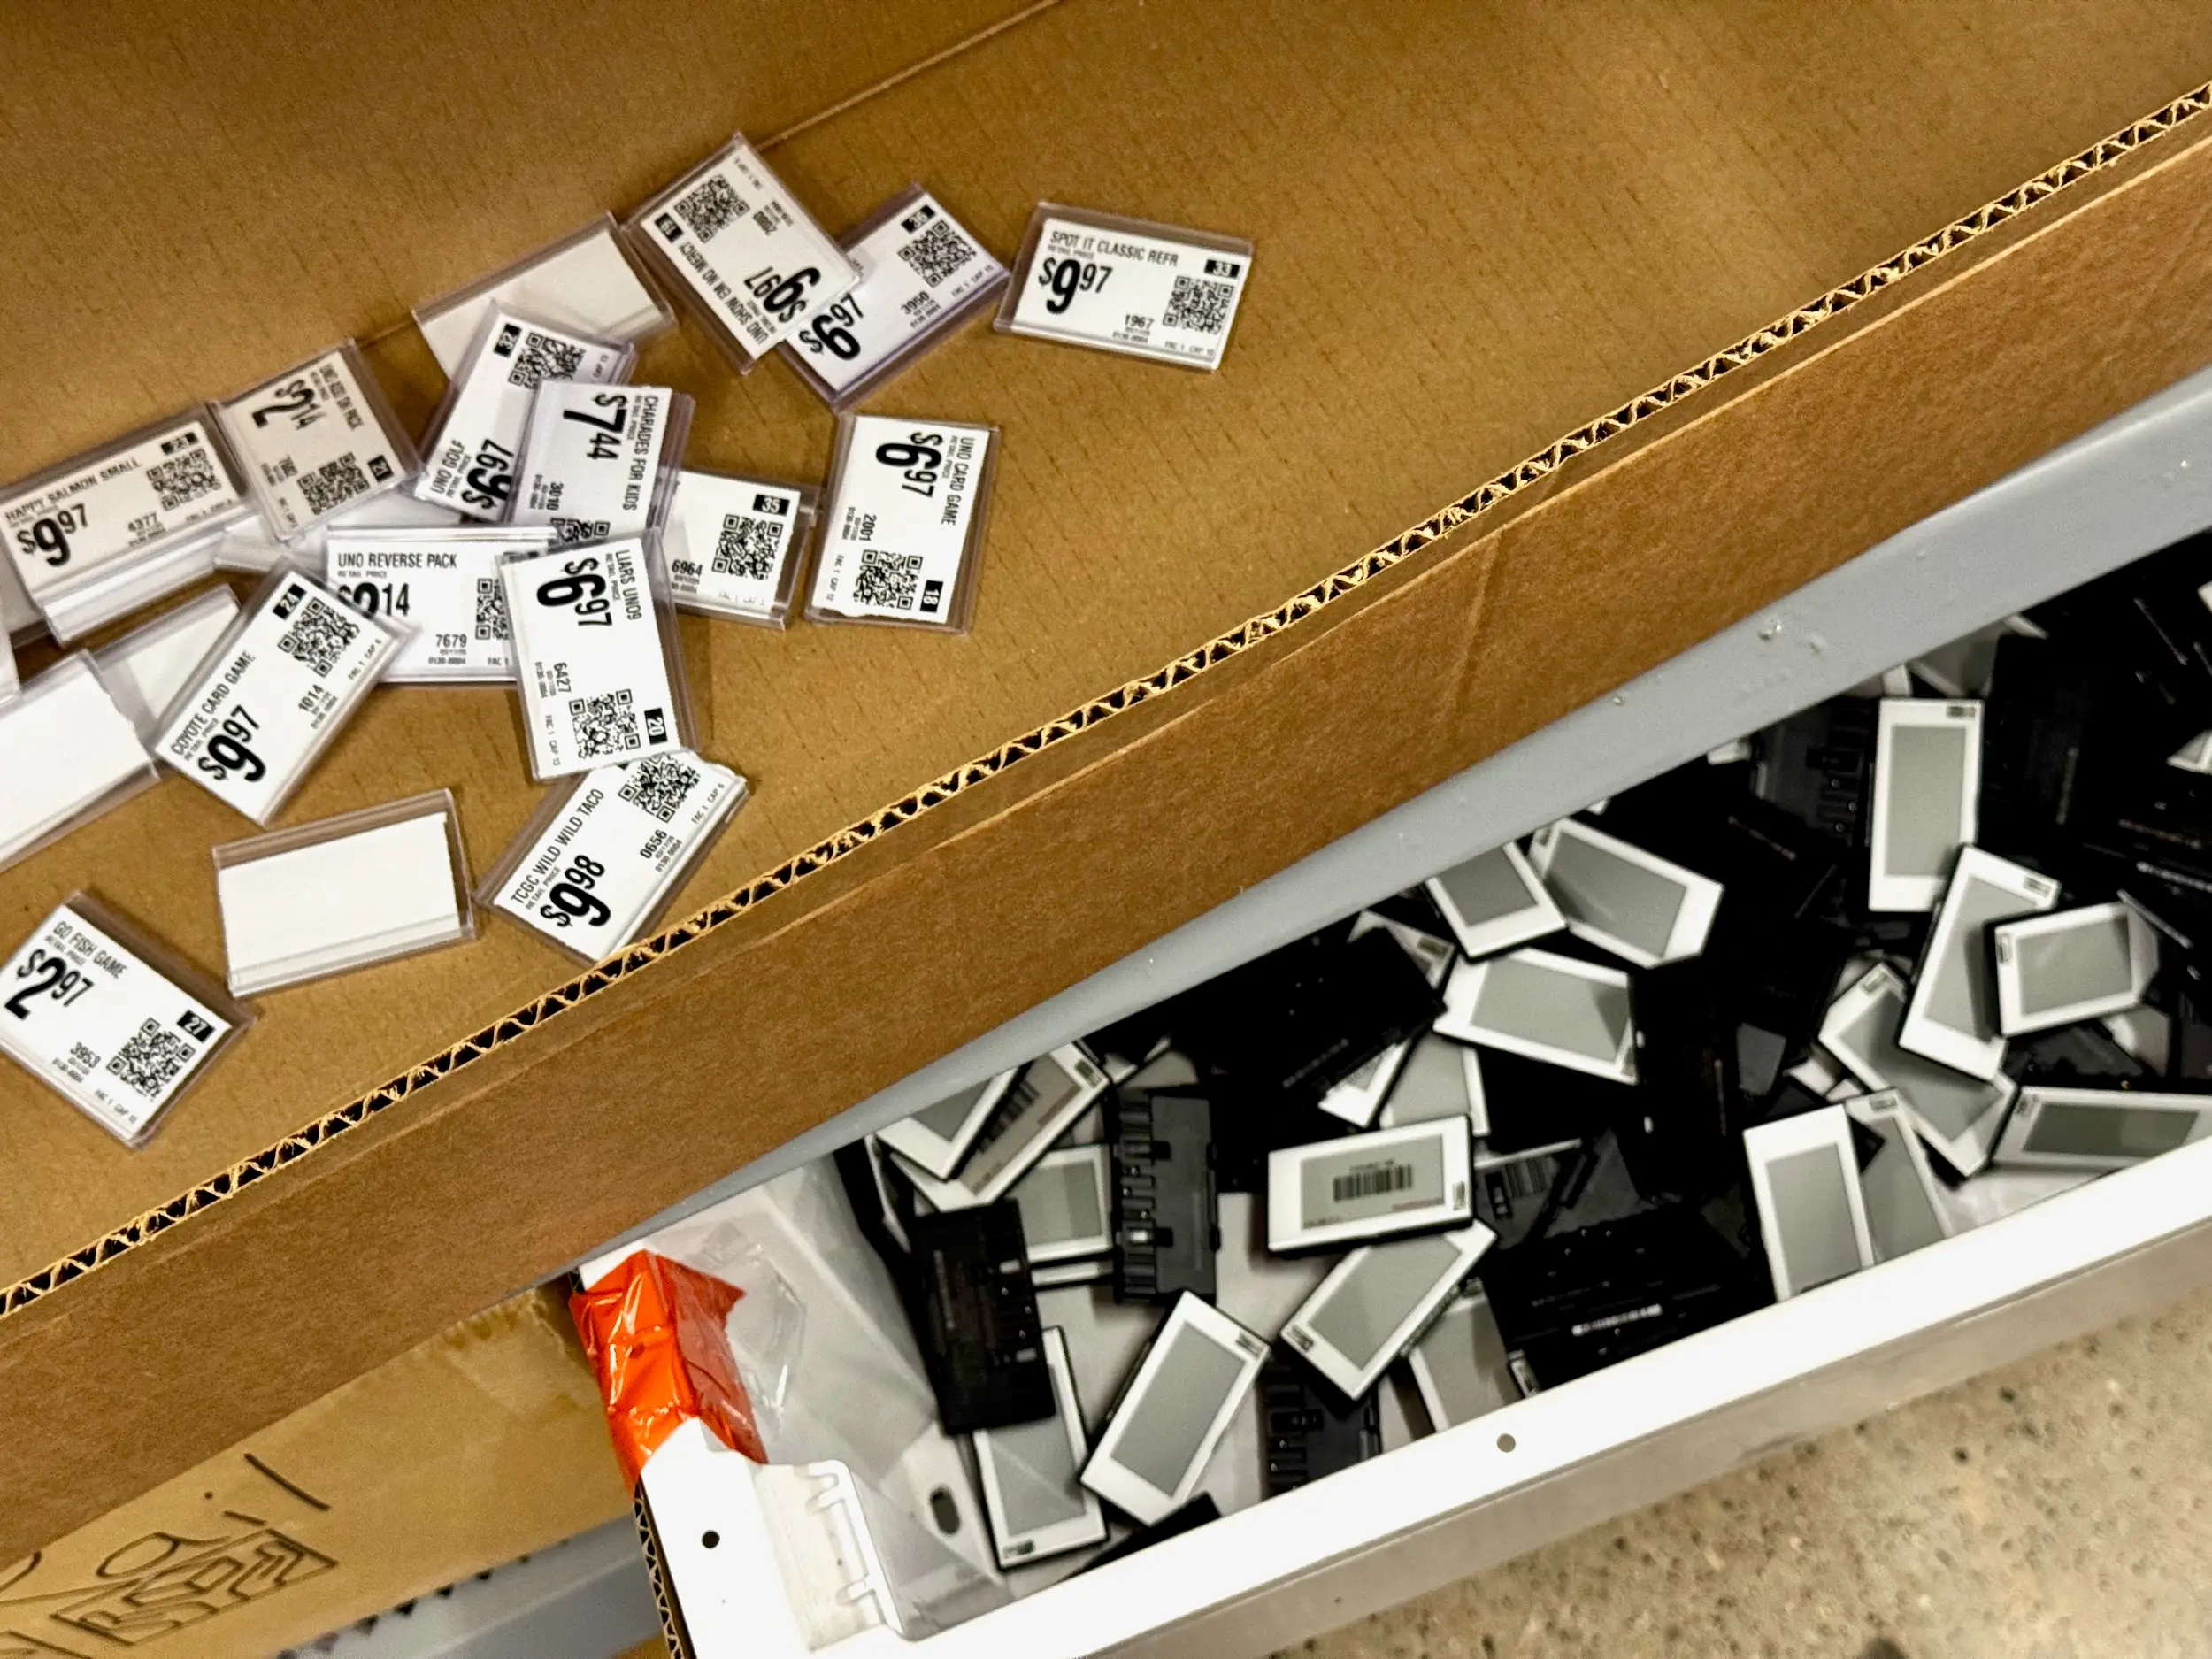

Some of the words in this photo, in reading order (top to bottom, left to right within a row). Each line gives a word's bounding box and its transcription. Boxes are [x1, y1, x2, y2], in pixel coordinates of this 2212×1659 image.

[678, 241, 709, 273] MERCY
[1049, 230, 1080, 247] SPOT
[1082, 236, 1095, 250] IT
[1096, 240, 1146, 261] CLASSIC
[1147, 250, 1179, 266] REFR
[702, 268, 719, 286] NO
[713, 282, 732, 300] EM
[901, 290, 932, 315] 3950
[725, 296, 753, 326] SHOW
[1125, 314, 1154, 329] 1967
[498, 330, 518, 349] 32
[746, 321, 769, 344] UNO
[634, 396, 659, 454] CHARADES
[441, 439, 465, 468] GOLF
[956, 437, 975, 459] UNO
[430, 469, 453, 495] UNO
[628, 458, 646, 480] FOR
[949, 463, 969, 491] CARD
[4, 498, 45, 523] HAPPY
[47, 475, 98, 504] SALMON
[98, 457, 141, 482] SMALL
[546, 482, 564, 511] 3010
[622, 484, 641, 511] KIDS
[762, 496, 780, 512] 35
[941, 494, 961, 525] GAME
[127, 511, 159, 533] 4377
[858, 514, 877, 541] 2001
[338, 553, 364, 567] UNO
[368, 552, 422, 568] REVERSE
[426, 553, 457, 568] PACK
[615, 549, 635, 584] LIARS
[672, 558, 703, 576] 6964
[279, 591, 300, 612] 24
[622, 588, 642, 620] UNO9
[922, 588, 941, 604] 18
[436, 634, 467, 648] 7679
[553, 662, 571, 693] 6427
[170, 713, 208, 756] COYOTE
[201, 683, 230, 715] CARD
[224, 650, 256, 685] GAME
[297, 684, 325, 712] 1014
[647, 716, 664, 735] 20
[510, 874, 540, 904] TCGC
[532, 845, 561, 875] WILD
[554, 816, 583, 846] WILD
[576, 788, 605, 816] TACO
[639, 829, 671, 859] 0656
[52, 920, 73, 940] GO
[68, 932, 97, 957] FISH
[93, 949, 127, 979] GAME
[183, 1015, 207, 1036] 27
[69, 1041, 101, 1069] 3953
